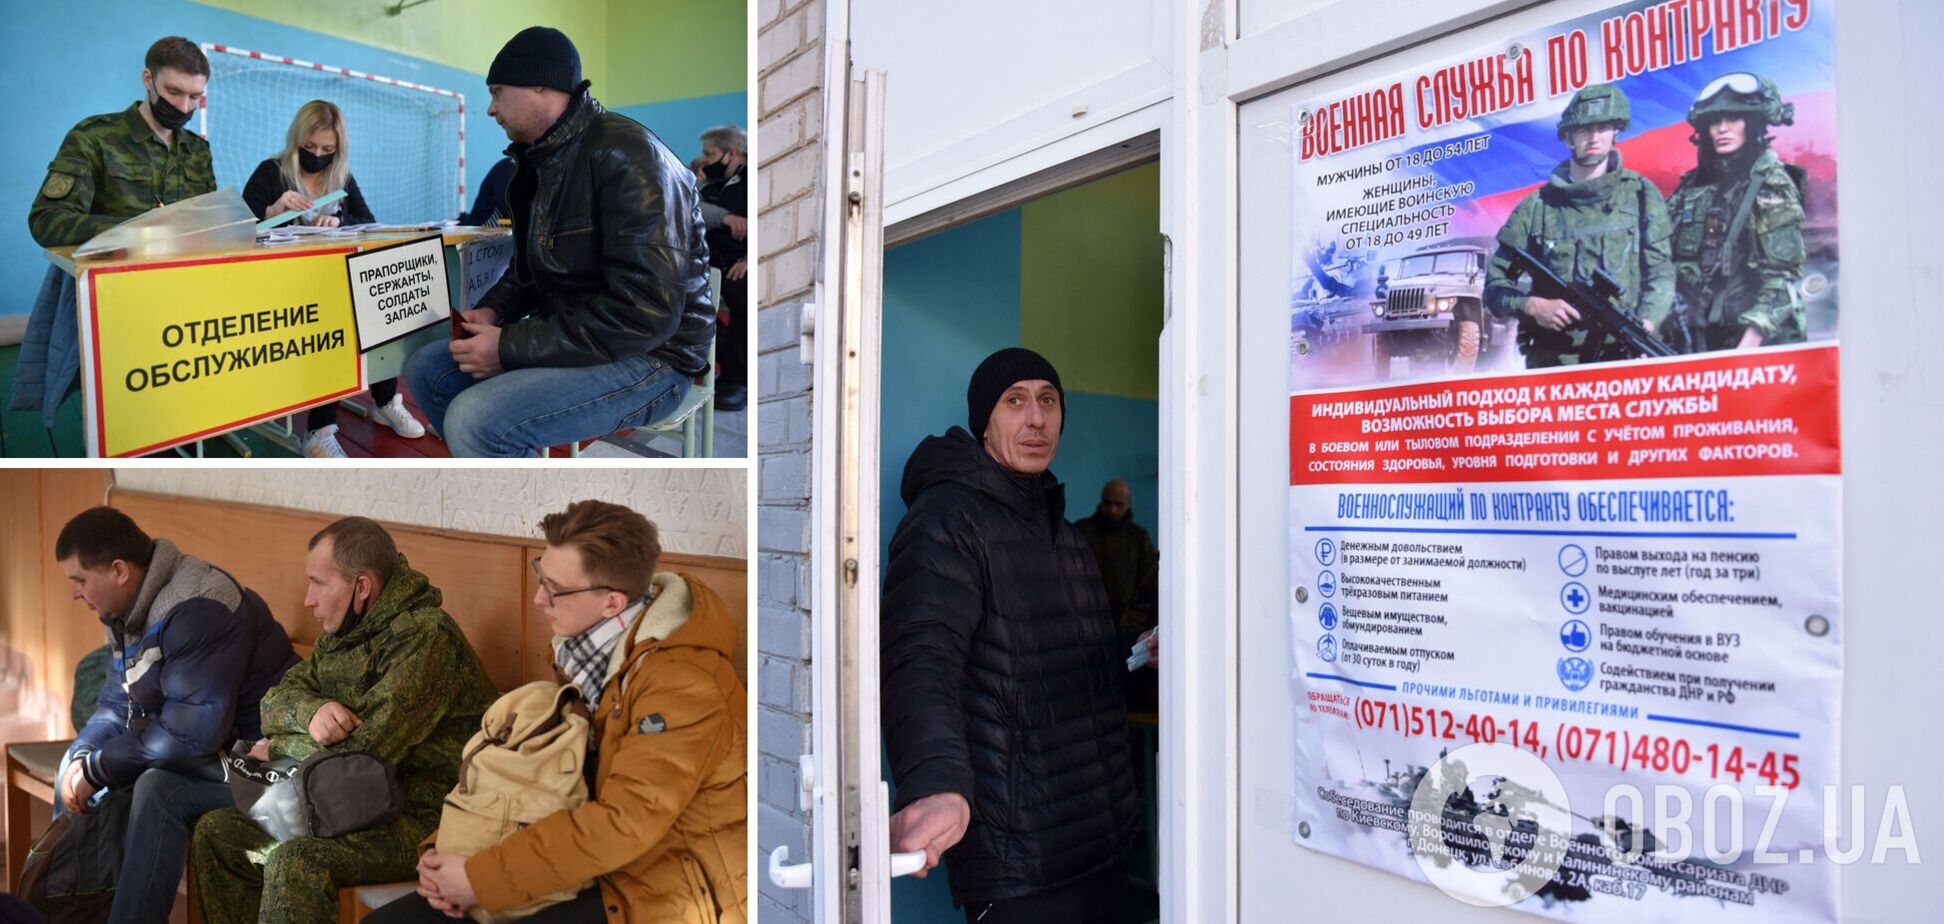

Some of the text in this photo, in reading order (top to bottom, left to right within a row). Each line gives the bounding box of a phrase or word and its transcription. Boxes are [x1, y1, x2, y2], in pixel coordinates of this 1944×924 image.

[1301, 82, 1405, 160] ВОЕННАЯ
[1416, 46, 1535, 128] СЛУЖБА
[1547, 30, 1589, 95] ПО
[1316, 136, 1490, 186] МУЖЧИНЫ ОТ 18 ДО 54 ЛЕТ
[1362, 174, 1436, 200] ЖЕНЩИНЫ,
[1326, 182, 1474, 222] ИМЕЮЩИЕ ВОИНСКУЮ
[1341, 204, 1456, 235] СПЕЦИАЛЬНОСТЬ
[1346, 222, 1449, 250] ОТ 18 ДО 49 ЛЕТ
[359, 254, 438, 284] ПРАПОРЩИКИ,
[369, 269, 434, 297] СЕРЖАНТЫ,
[378, 286, 430, 311] СОЛДАТЫ
[162, 303, 320, 348] ОТДЕЛЕНИЕ
[385, 302, 428, 325] ЗАПАСА
[125, 329, 345, 392] ОБСЛУЖИВАНИЯ
[1312, 364, 1798, 419] ИНДИВИДУАЛЬНЫЙ ПОДХОД К КАЖДОМУ КАНДИДАТУ,
[1362, 395, 1718, 434] ВОЗМОЖНОСТЬ ВЫБОРА МЕСТА СЛУЖБЫ
[1309, 418, 1798, 454] В БОЕВОМ ИЛИ ТЫЛОВОМ ПОДРАЗДЕЛЕНИИ С УЧЁТОМ ПРОЖИВАНИЯ,
[1308, 443, 1798, 472] СОСТОЯНИЯ ЗДОРОВЬЯ, УРОВНЯ ПОДГОТОВКИ И ДРУГИХ ФАКТОРОВ.
[1338, 488, 1735, 522] ВОЕННОСЛУЖАЩИЙ ПО КОНТРАКТУ ОБЕСПЕЧИВАЕТСЯ:
[1340, 540, 1462, 554] Денежным довольствием
[1595, 546, 1760, 563] Правом выхода на пенсию
[1350, 555, 1388, 568] размере
[1390, 556, 1400, 566] от
[1402, 556, 1465, 568] занимаемой
[1467, 558, 1526, 572] должности)
[1596, 564, 1760, 582] по выслуге лет (год за три)
[1340, 572, 1441, 588] Высококачественным
[1400, 590, 1448, 602] питанием
[1598, 585, 1783, 609] Медицинским обеспечением,
[1599, 602, 1674, 618] вакцинацией
[1342, 606, 1448, 626] Вещевым имуществом,
[1342, 620, 1422, 636] обмундированием
[1600, 623, 1741, 648] Правом обучения в ВУЗ
[1352, 654, 1362, 666] 30
[1362, 658, 1387, 670] суток
[1396, 660, 1420, 674] году)
[1410, 648, 1454, 661] отпуском
[1600, 640, 1729, 664] на бюджетной основе
[1600, 662, 1775, 692] Содействием при получении
[1402, 682, 1639, 719] ПРОЧИМИ ЛЬГОТАМИ И ПРИВИЛЕГИЯМИ
[1600, 680, 1736, 704] гражданства ДНР и РФ
[1354, 696, 1800, 790] (071)512-40-14, (071)480-14-45
[1317, 786, 1406, 818] Собеседование
[1674, 878, 1754, 906] районам
